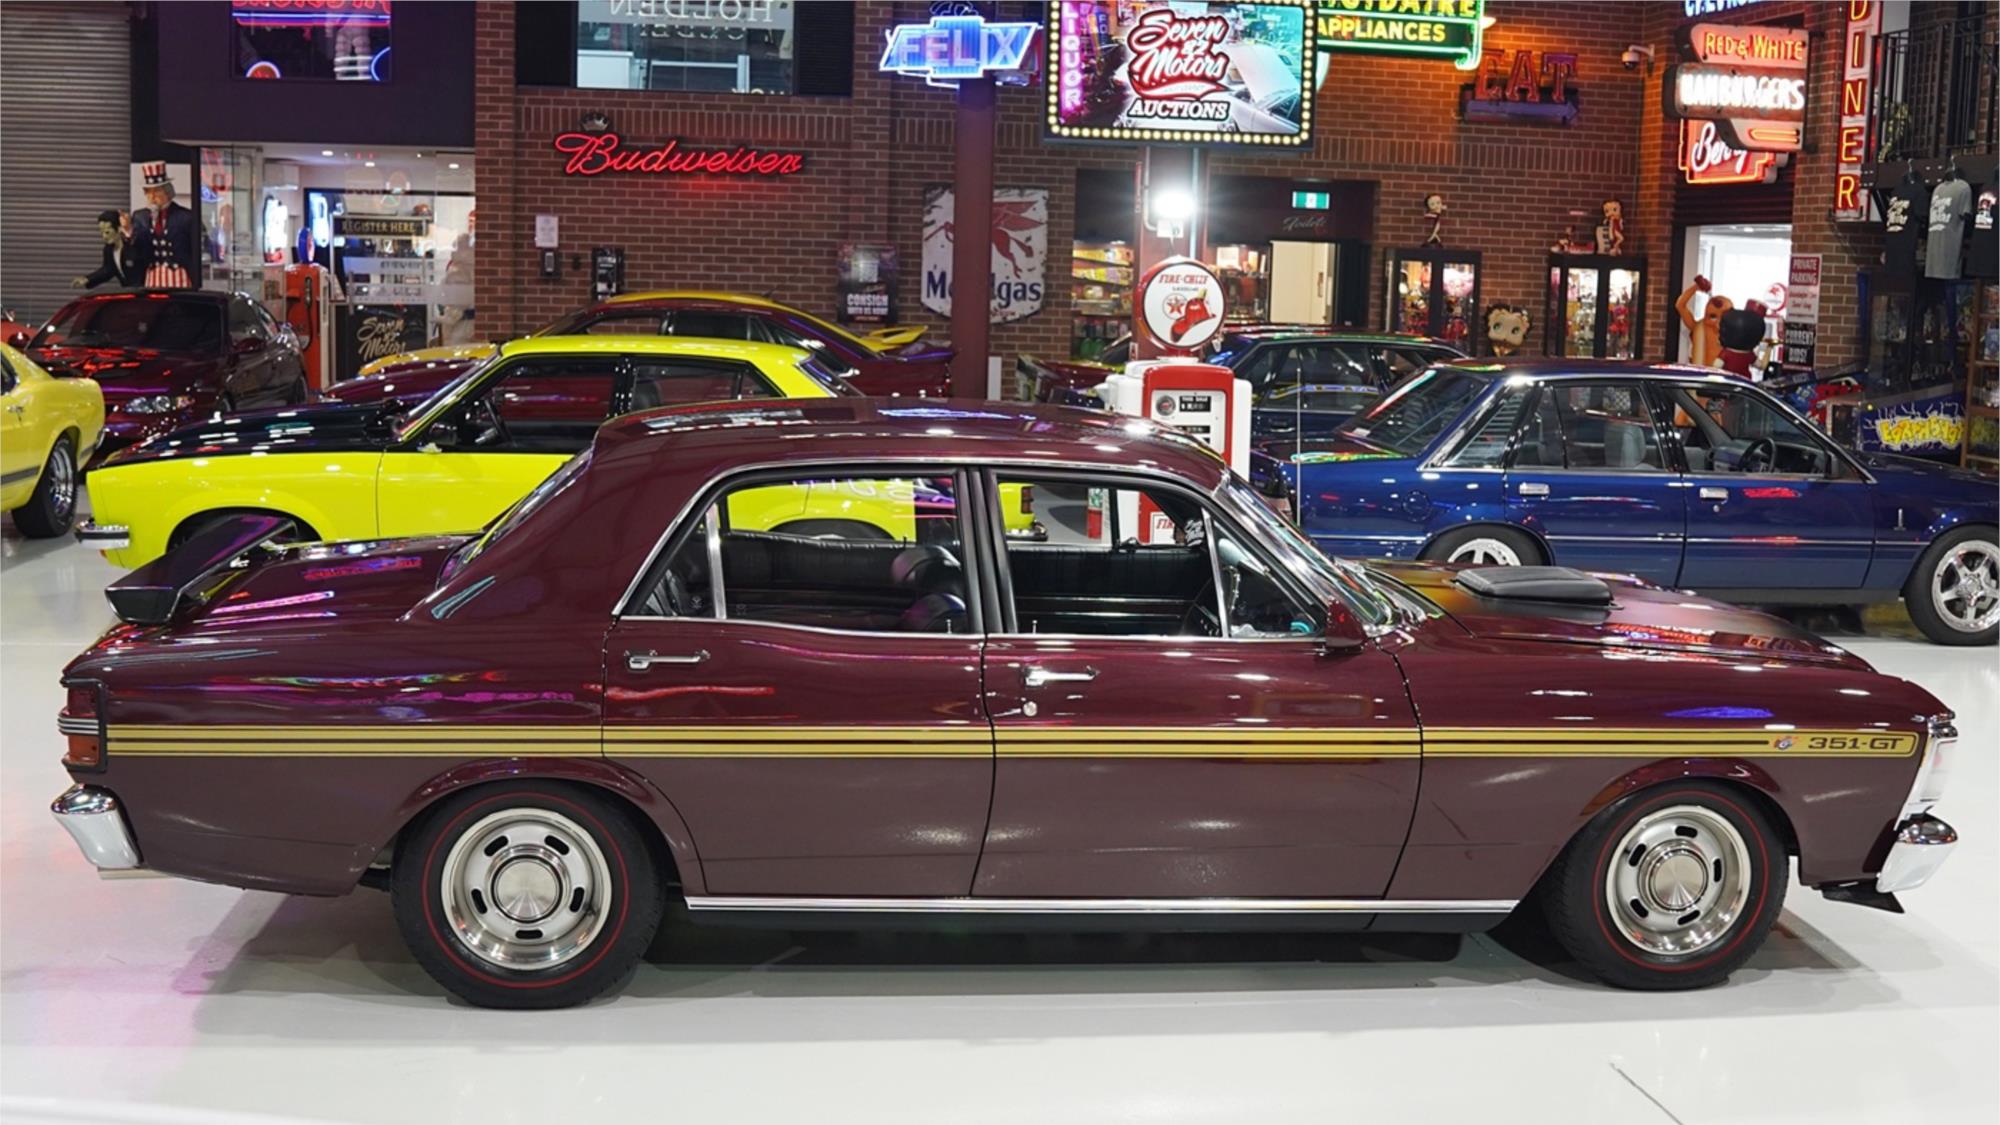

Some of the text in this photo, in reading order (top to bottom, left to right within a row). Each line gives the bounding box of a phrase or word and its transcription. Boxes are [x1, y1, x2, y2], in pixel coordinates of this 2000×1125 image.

[898, 28, 1020, 67] FELIX
[1130, 12, 1225, 51] Seven
[1317, 16, 1446, 42] APPLIANCES
[1705, 33, 1804, 60] RED & WHITE
[1061, 2, 1082, 111] LIQUOR
[1131, 46, 1227, 84] Motors
[1474, 48, 1579, 103] EAT
[1129, 99, 1228, 119] AUCTIONS
[1679, 73, 1805, 110] HAMBURGERS
[1837, 0, 1868, 209] DINER
[555, 133, 803, 175] Budweiser
[341, 220, 416, 233] REGISTER HERE
[926, 271, 1042, 309] Mlgas
[1808, 737, 1904, 750] 351-GT
